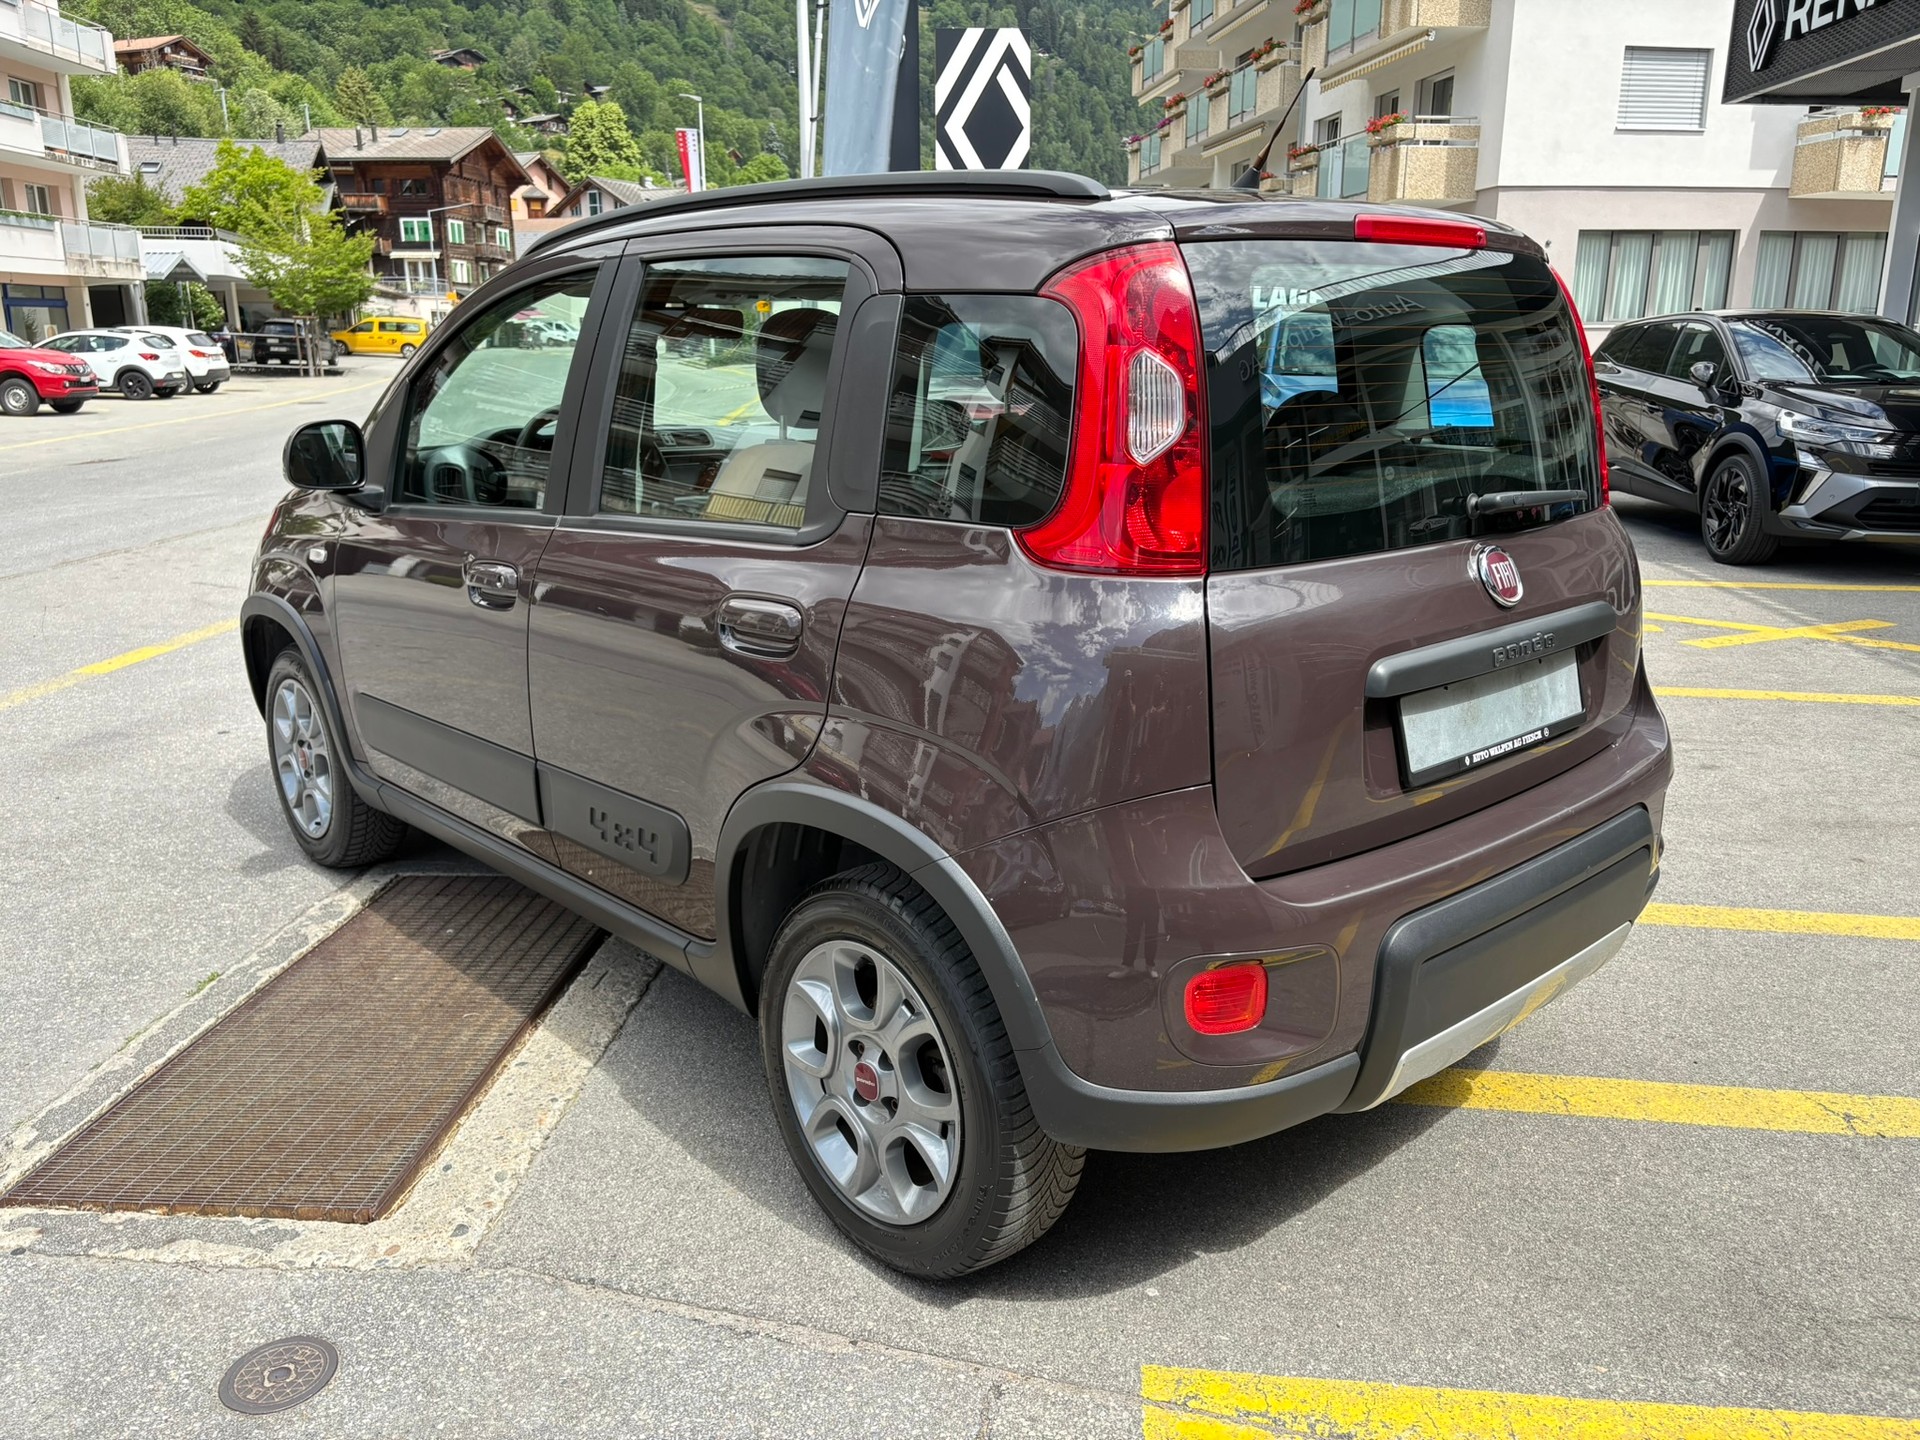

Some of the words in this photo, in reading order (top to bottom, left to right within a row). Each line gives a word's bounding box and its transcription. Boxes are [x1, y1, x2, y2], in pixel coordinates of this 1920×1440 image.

[1490, 560, 1516, 590] FIAT
[1472, 750, 1489, 763] AUTO
[1489, 741, 1513, 756] WALPEN
[589, 806, 659, 865] 4x4
